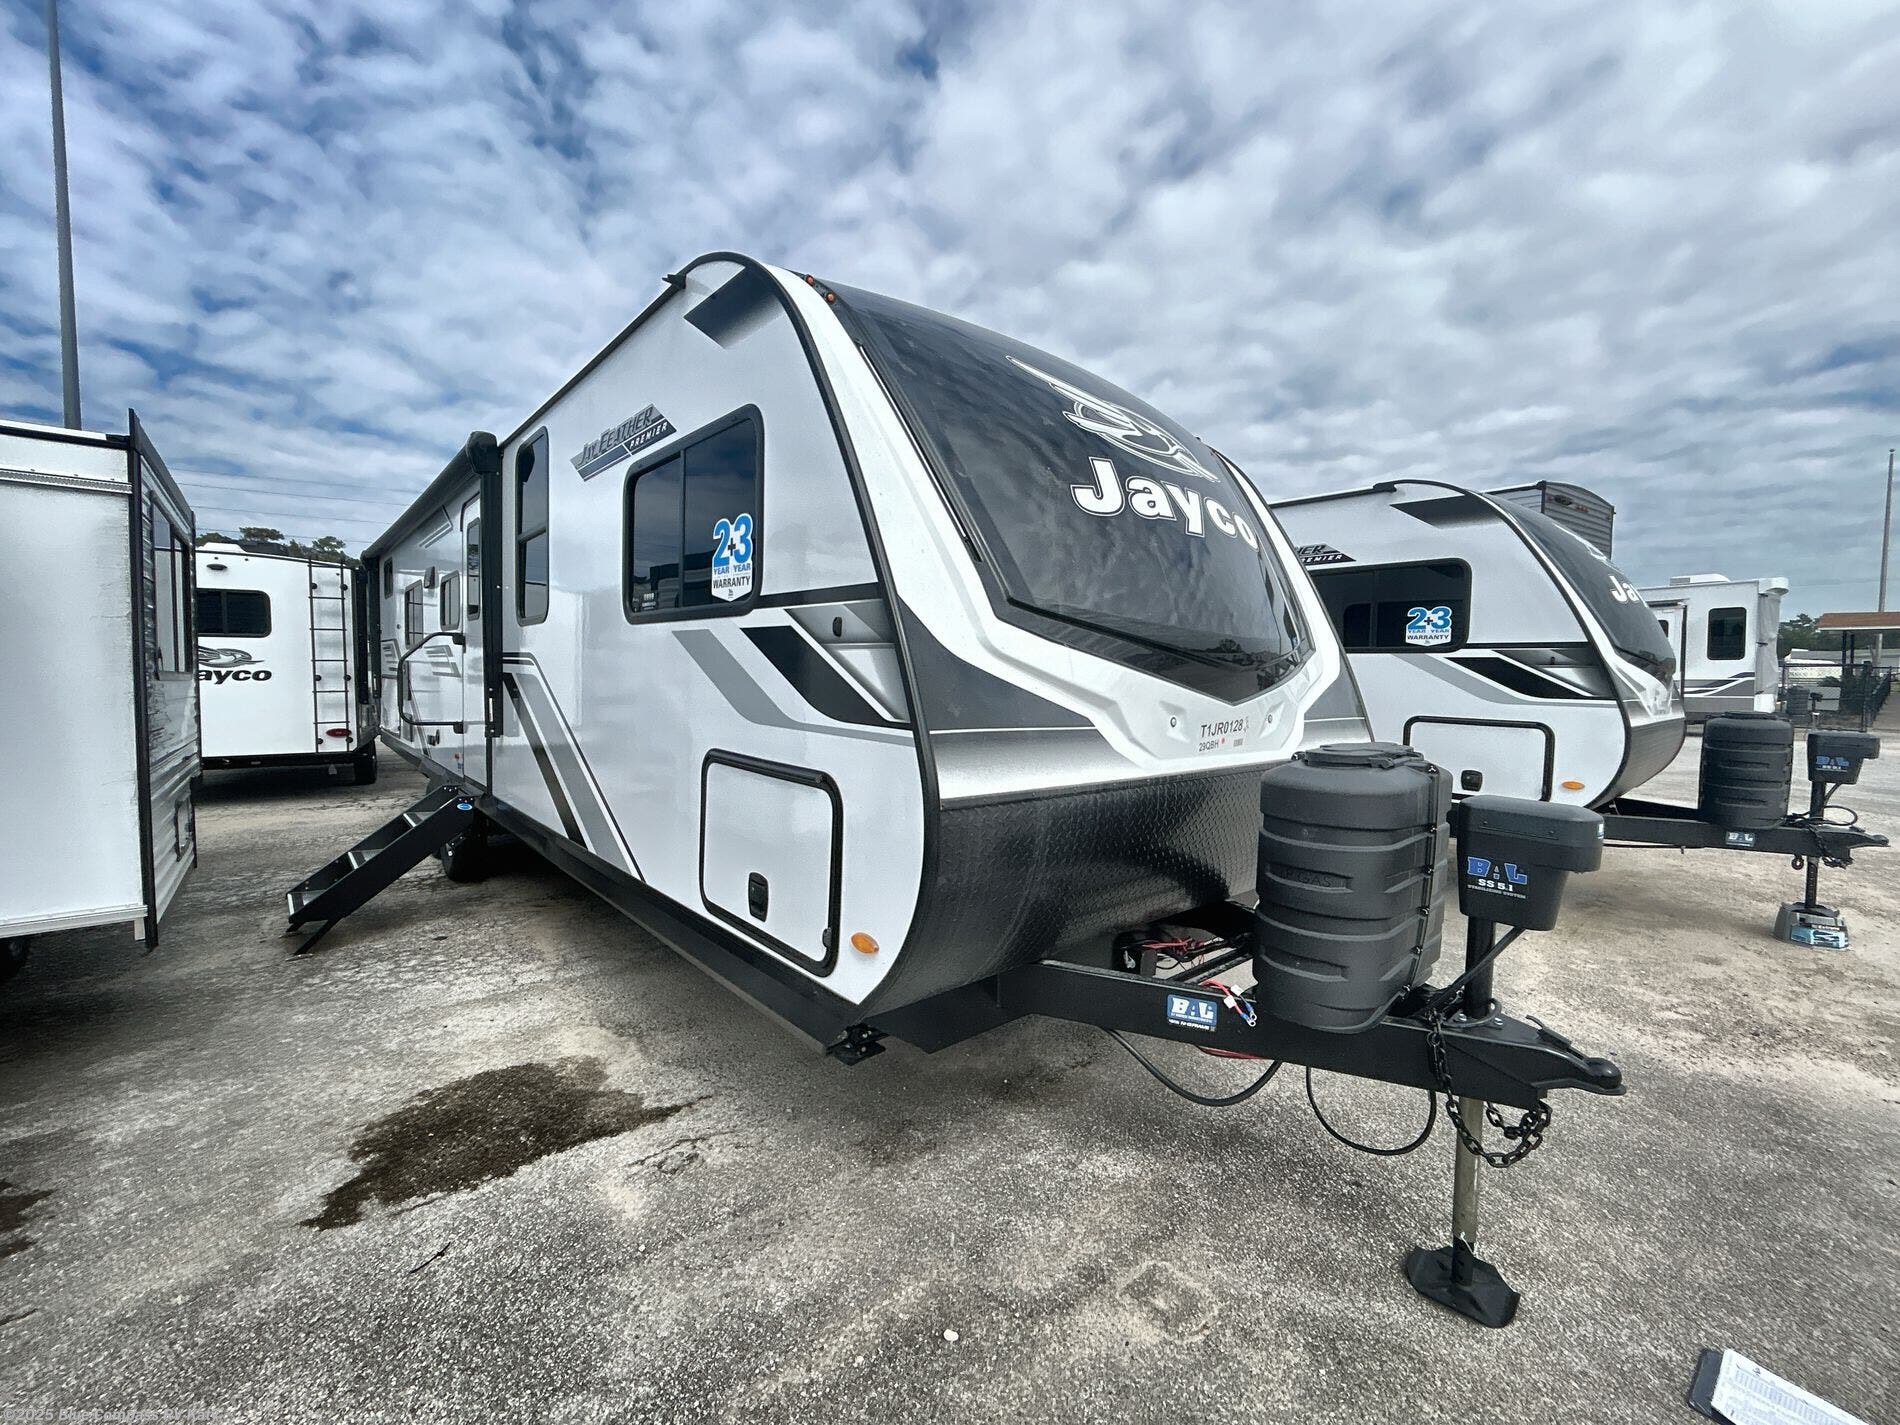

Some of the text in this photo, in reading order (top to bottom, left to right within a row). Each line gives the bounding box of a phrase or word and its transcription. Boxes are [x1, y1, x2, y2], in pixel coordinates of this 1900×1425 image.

[629, 421, 668, 449] PREMIER
[1070, 456, 1259, 551] Jayco
[714, 566, 729, 575] YEAR
[734, 562, 752, 573] YEAR
[713, 576, 751, 589] WARRANTY
[1200, 718, 1244, 738] T1JR0128
[1467, 856, 1528, 885] BAL
[1478, 878, 1495, 888] SS
[1171, 997, 1215, 1020] BAL
